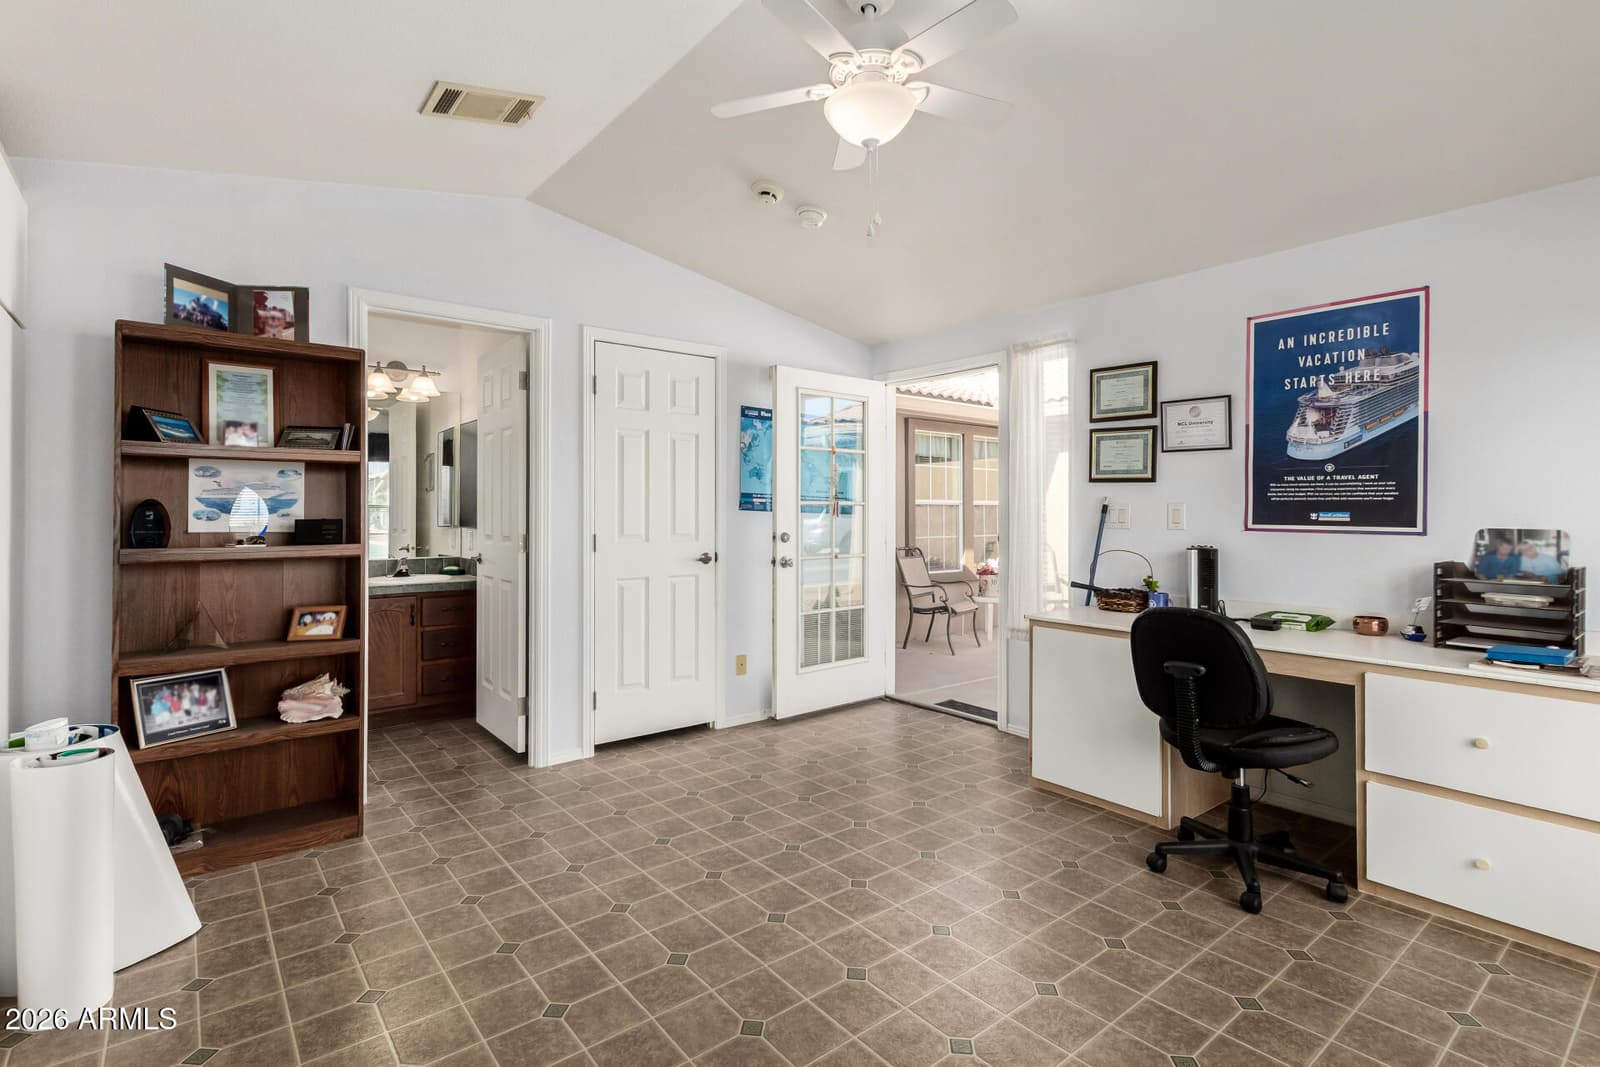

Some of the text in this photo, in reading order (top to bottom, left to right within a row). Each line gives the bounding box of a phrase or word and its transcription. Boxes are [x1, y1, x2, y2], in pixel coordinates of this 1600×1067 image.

[1278, 322, 1390, 350] AN INCREDIBLE
[1298, 348, 1366, 368] VACATION
[1284, 368, 1381, 390] STARTS HERE
